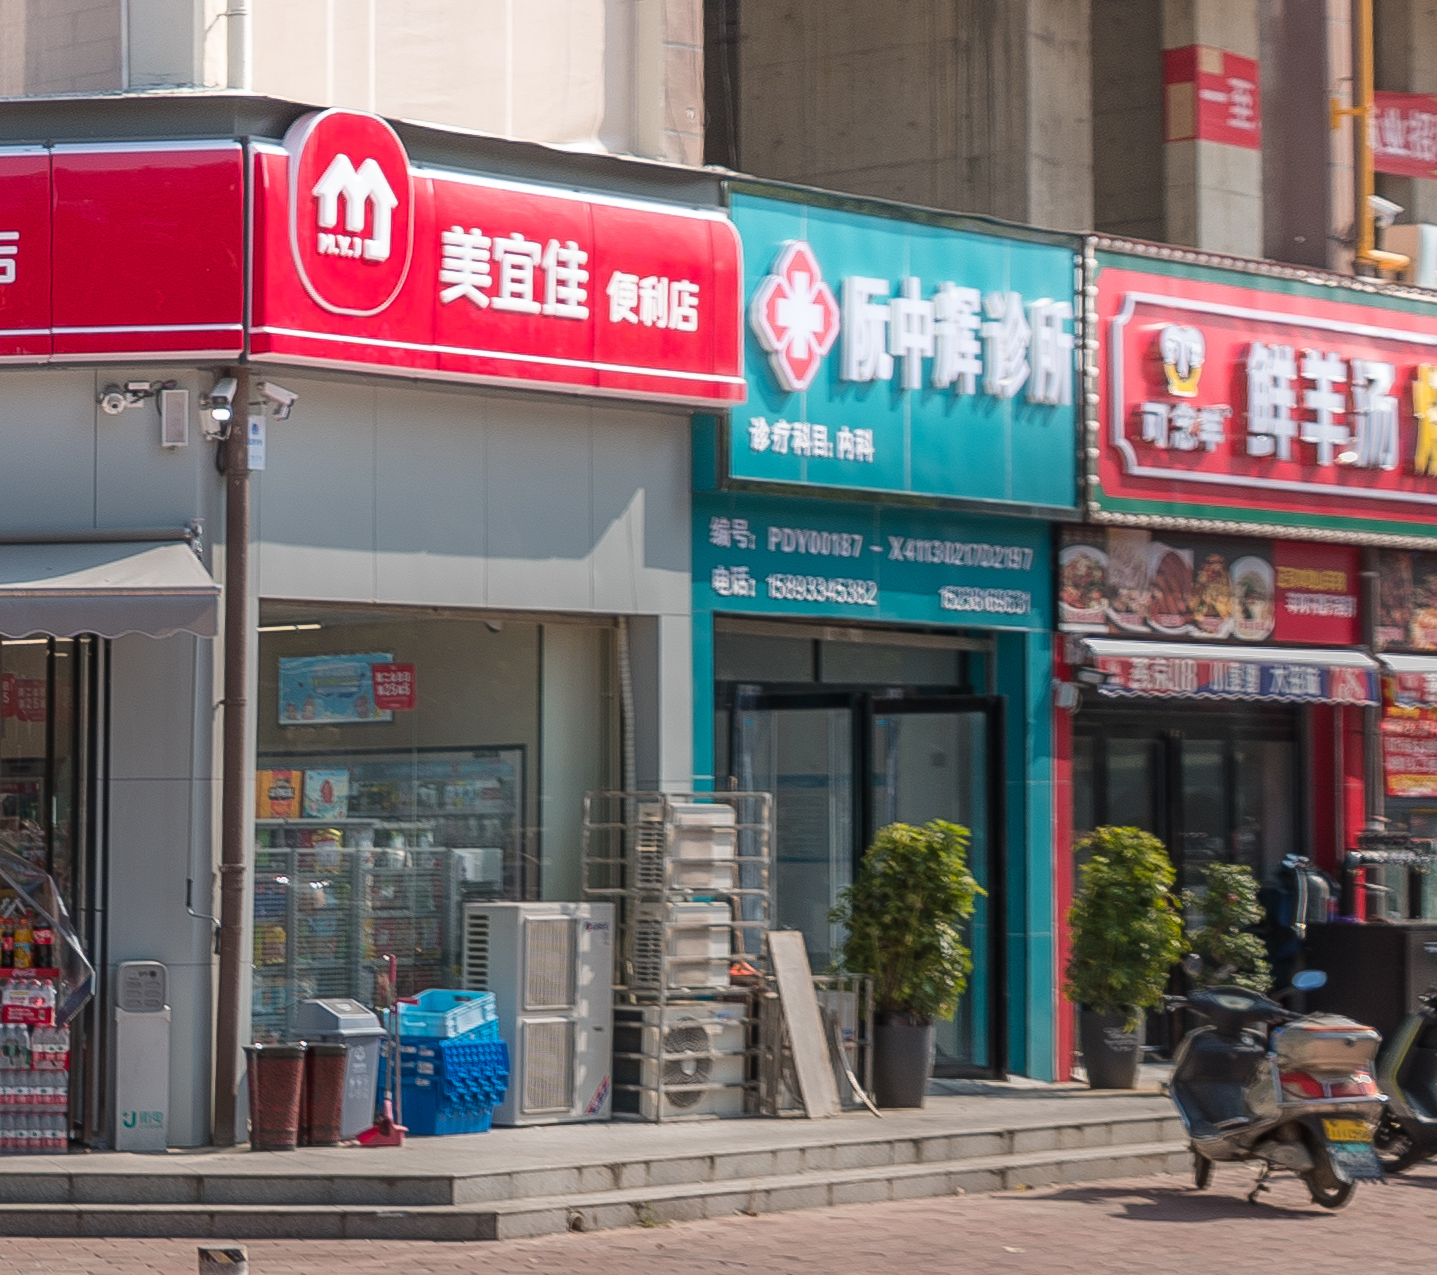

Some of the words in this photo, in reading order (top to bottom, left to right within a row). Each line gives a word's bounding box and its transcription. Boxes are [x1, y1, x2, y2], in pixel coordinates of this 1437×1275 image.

[439, 225, 590, 321] 美宜佳
[604, 271, 700, 335] 便利店
